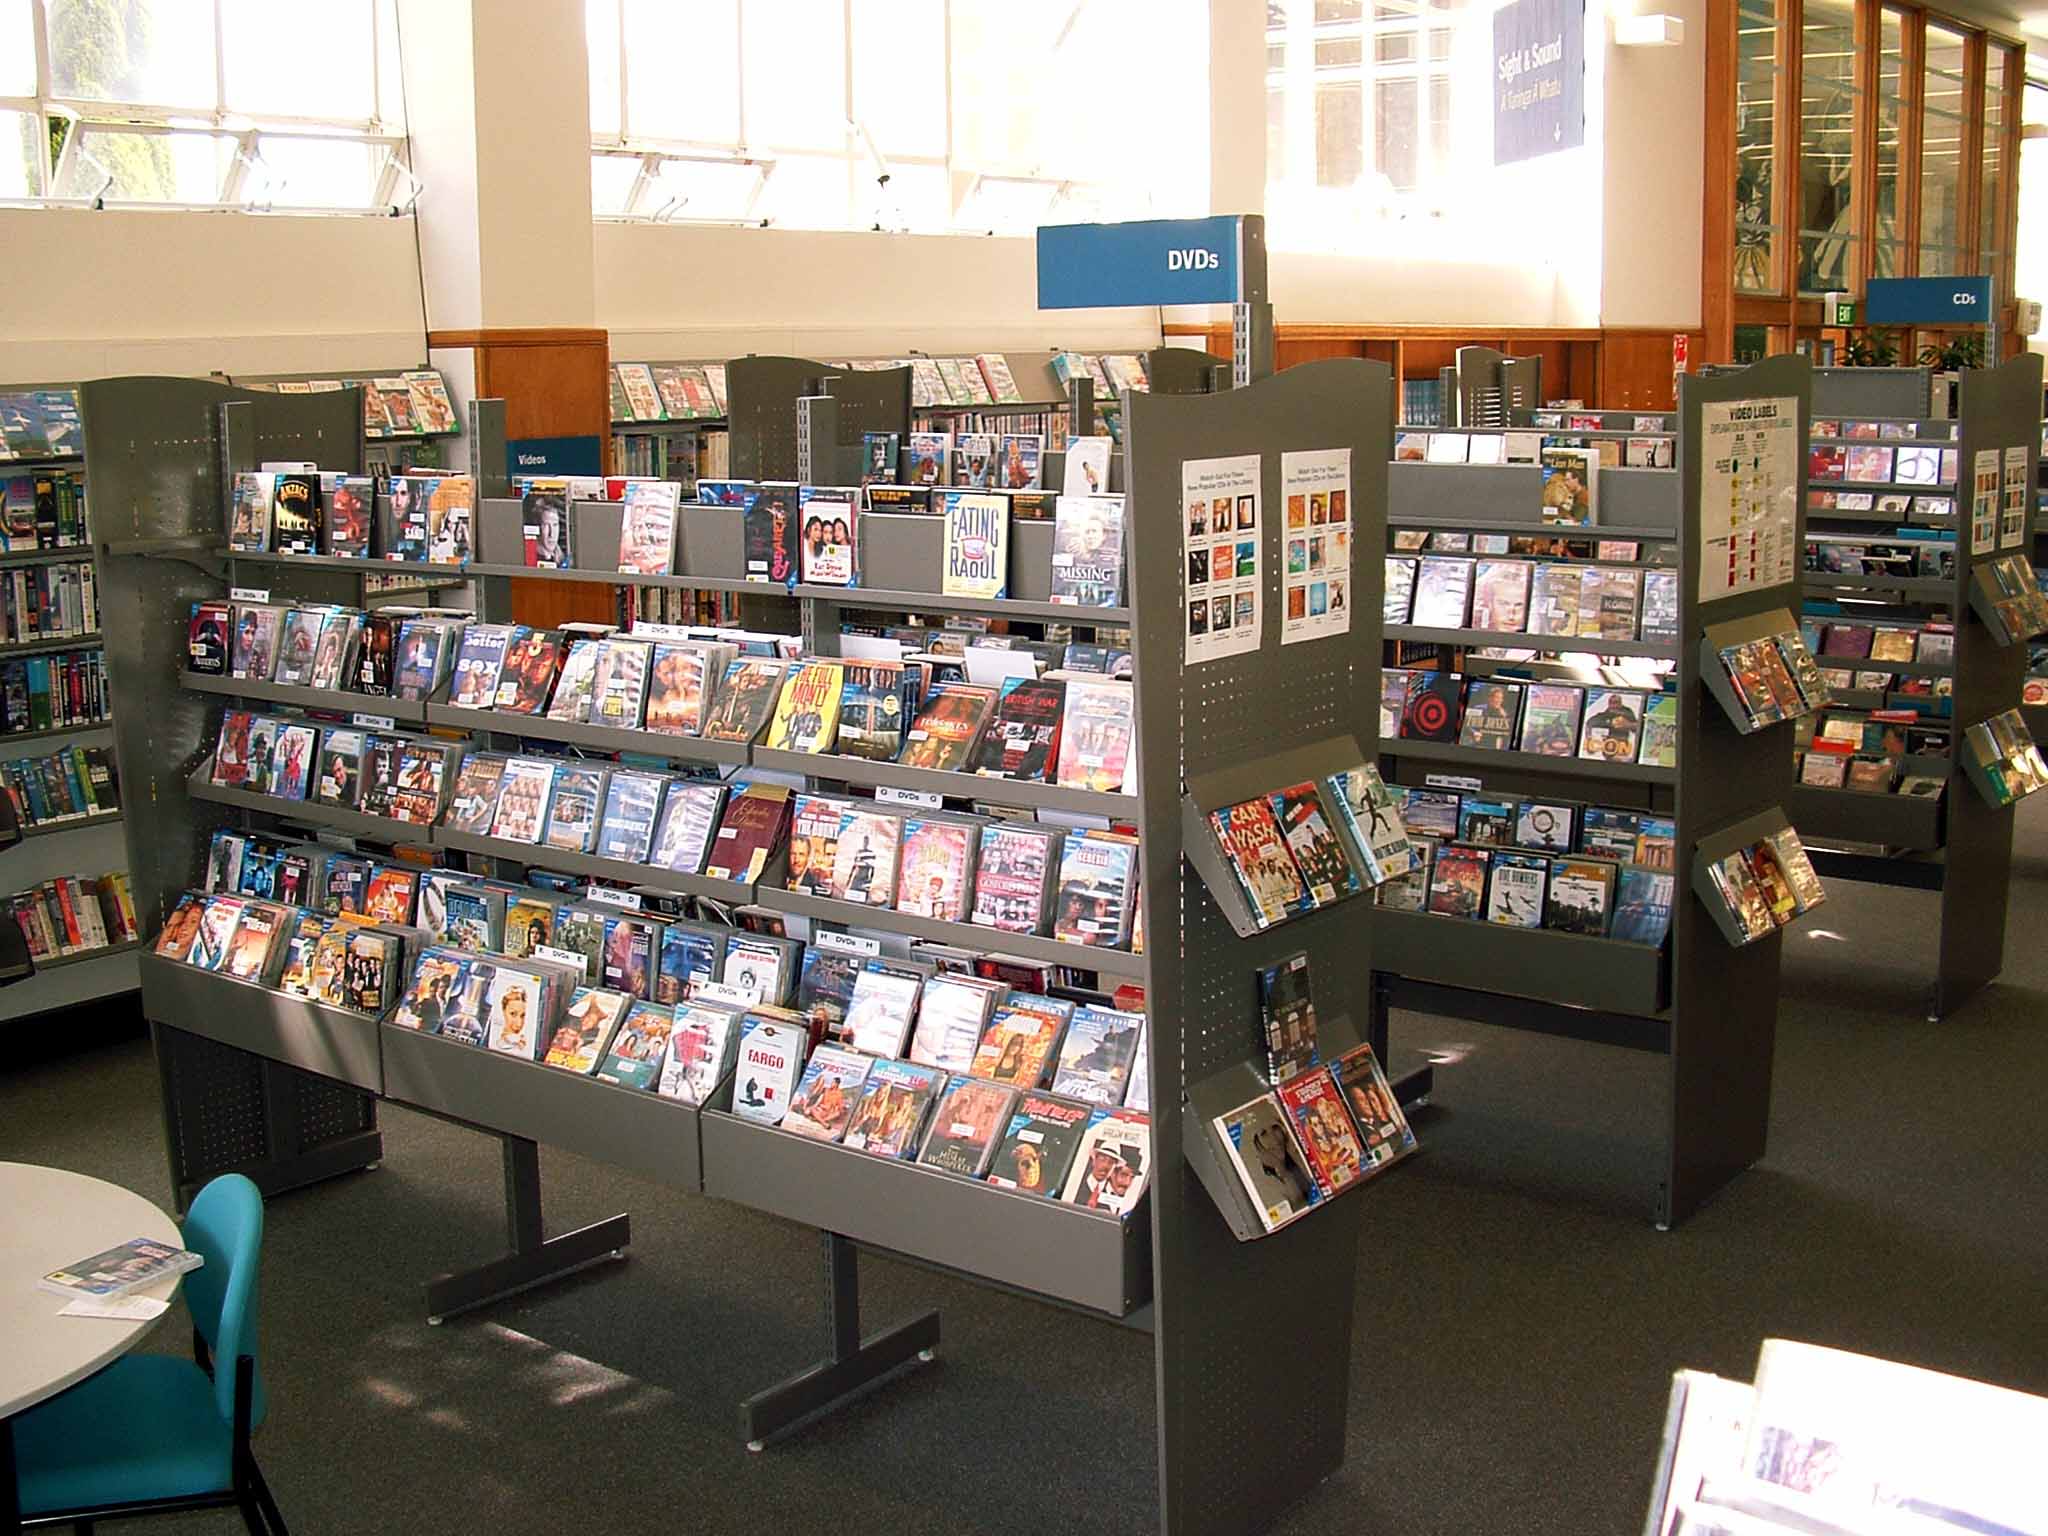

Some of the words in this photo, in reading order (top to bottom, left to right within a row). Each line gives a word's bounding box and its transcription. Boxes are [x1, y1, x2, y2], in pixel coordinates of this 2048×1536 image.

[1499, 49, 1522, 83] Sight
[1524, 50, 1531, 72] &
[1532, 33, 1562, 68] Sound
[1168, 249, 1219, 270] DVDs
[1952, 293, 1977, 305] CDs
[1729, 407, 1752, 421] VIDEO
[1753, 405, 1777, 418] LABELS
[518, 454, 547, 465] Videos
[280, 482, 309, 502] ANZACS
[952, 507, 999, 548] EATING
[950, 550, 997, 580] RAOUL
[1059, 566, 1111, 582] MISSING
[457, 658, 499, 675] sex
[898, 791, 920, 801] DVDs
[1229, 804, 1261, 825] CAR
[1229, 824, 1275, 849] WASH
[591, 888, 597, 896] D
[603, 891, 620, 900] DVDs
[628, 895, 634, 903] D
[820, 932, 827, 940] H
[836, 936, 856, 946] DVDs
[552, 950, 569, 959] DVDs
[718, 986, 737, 996] DVDs
[748, 1050, 784, 1070] FARGO
